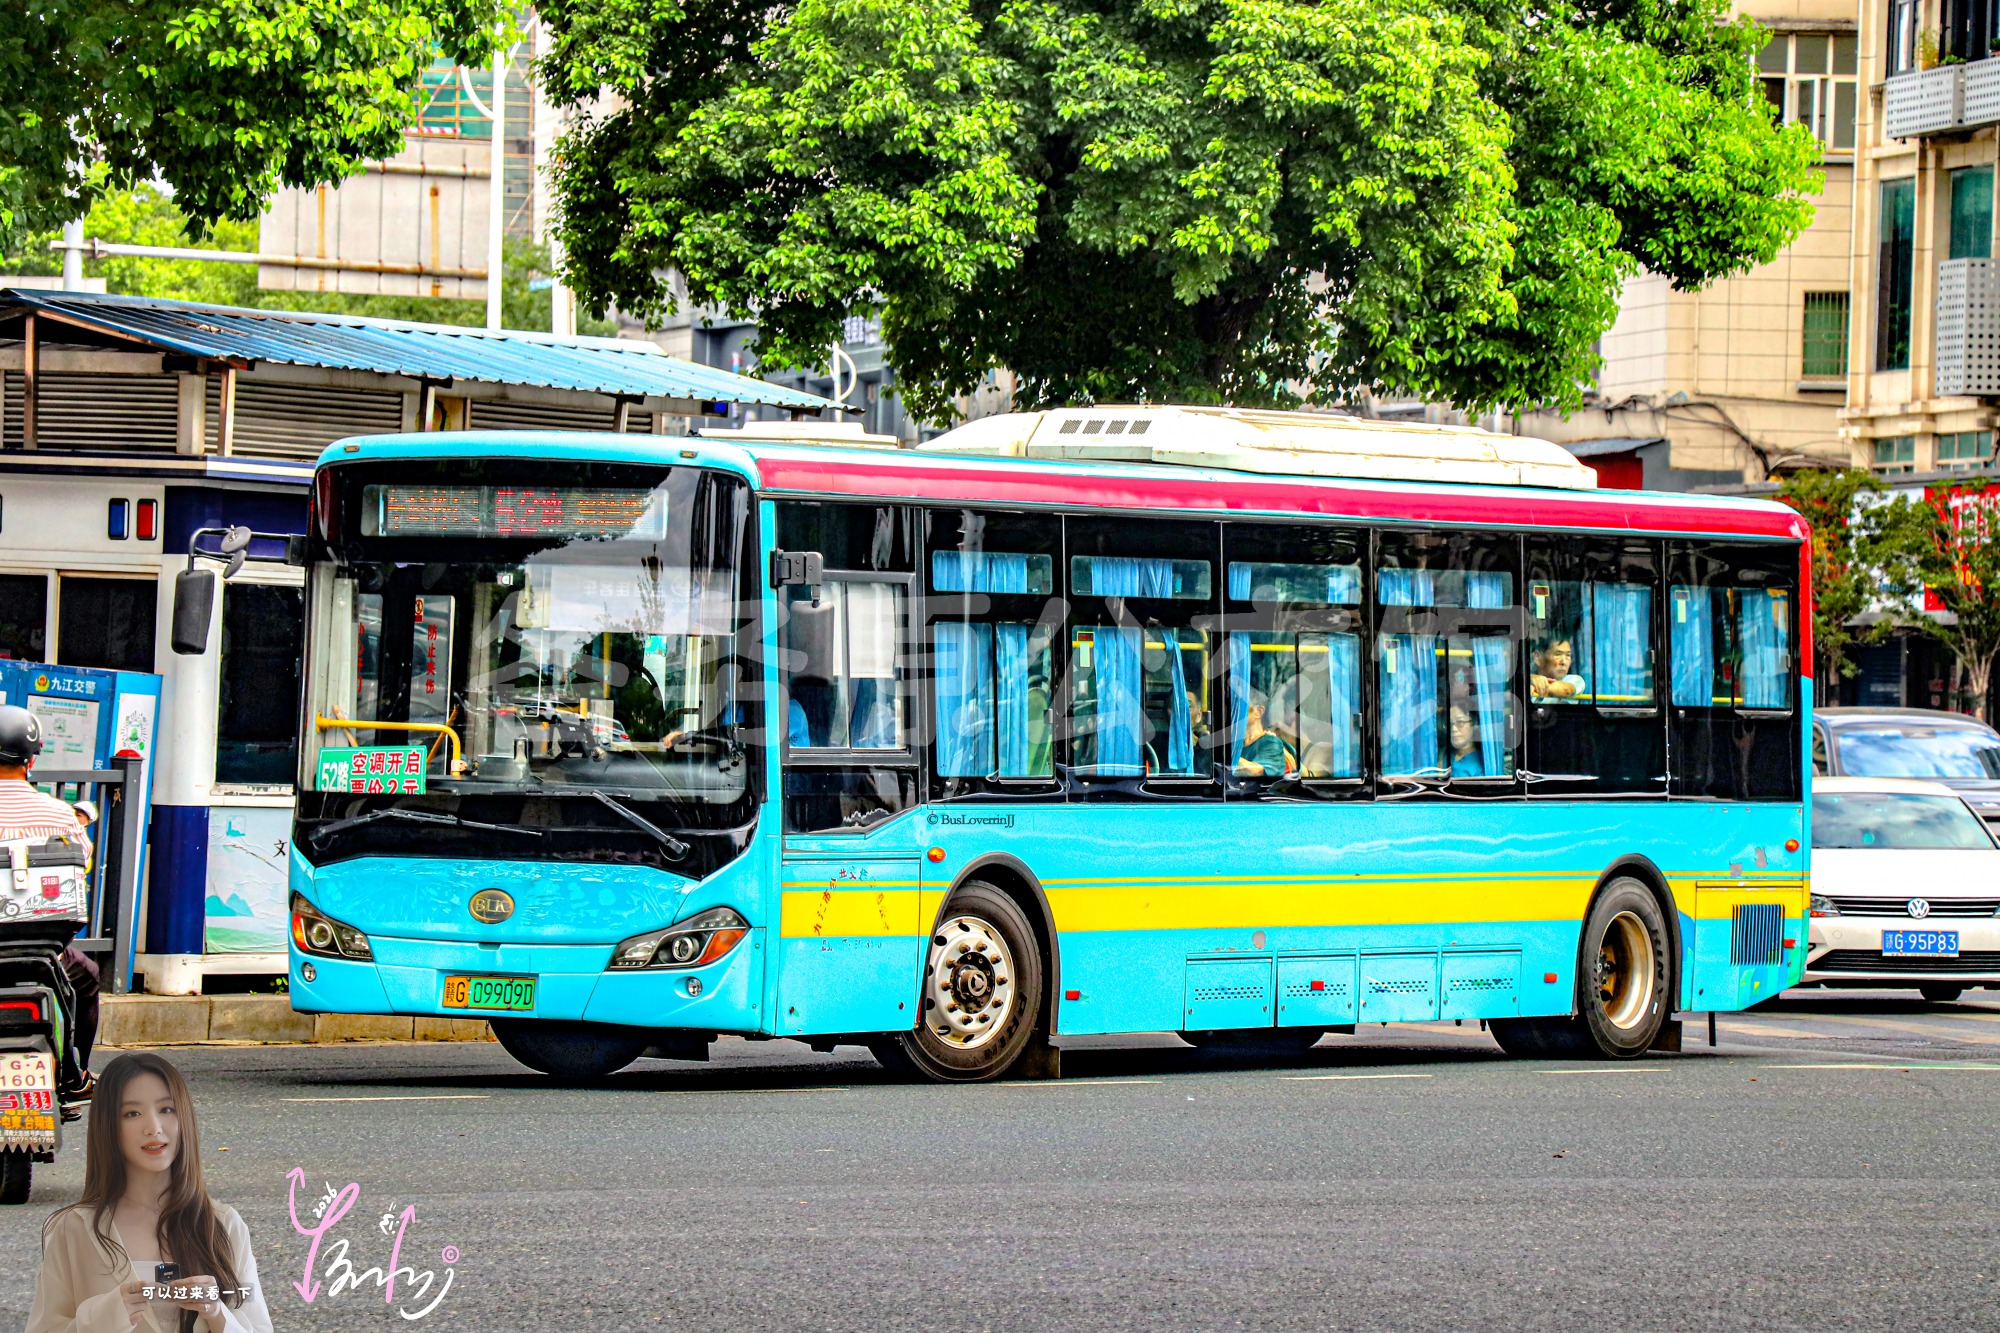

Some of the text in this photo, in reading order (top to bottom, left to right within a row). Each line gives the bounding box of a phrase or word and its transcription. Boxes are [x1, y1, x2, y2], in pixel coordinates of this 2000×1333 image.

[425, 624, 438, 694] 防止夹伤
[51, 678, 96, 694] 九江交警
[350, 750, 421, 775] 空调开启
[273, 839, 288, 857] 文
[42, 877, 56, 885] 318
[0, 1060, 46, 1071] G·A
